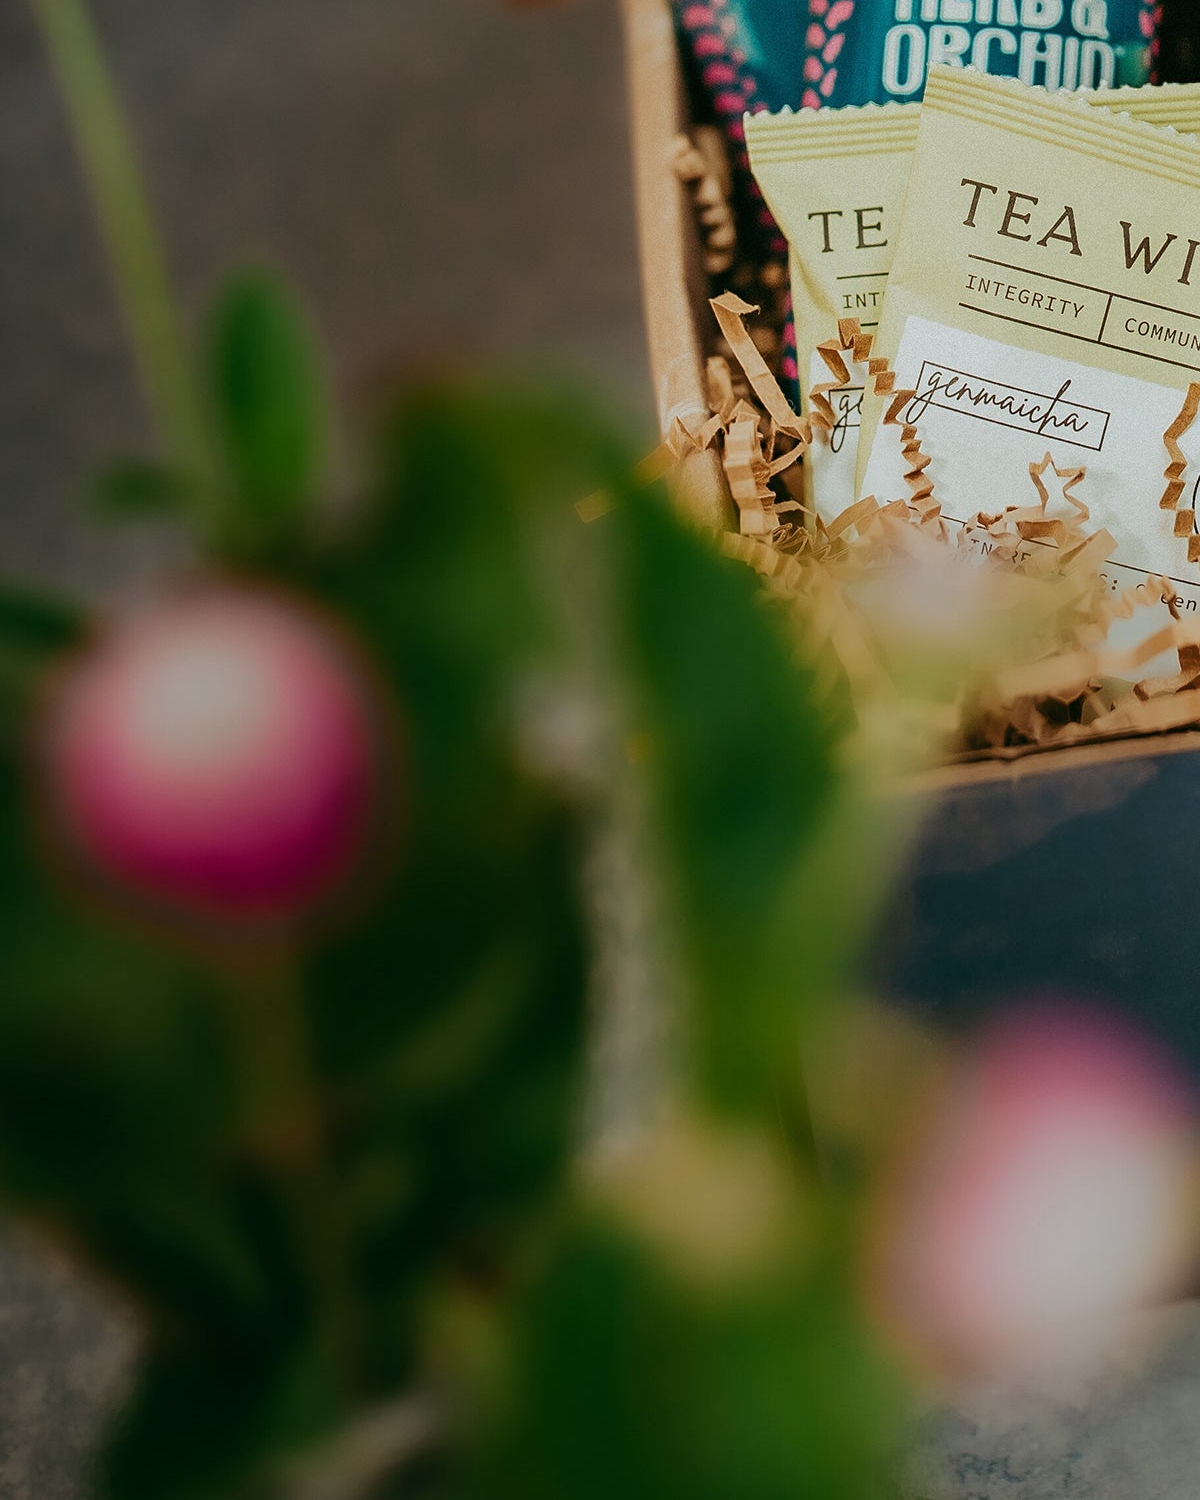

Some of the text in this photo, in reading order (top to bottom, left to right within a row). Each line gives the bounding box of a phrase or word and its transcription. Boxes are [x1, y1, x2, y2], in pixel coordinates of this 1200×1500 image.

[881, 23, 1116, 96] ORCHID
[960, 177, 1083, 257] TEA
[842, 291, 886, 309] INT
[964, 273, 1085, 318] INTEGRITY
[906, 371, 1088, 435] genmaicha
